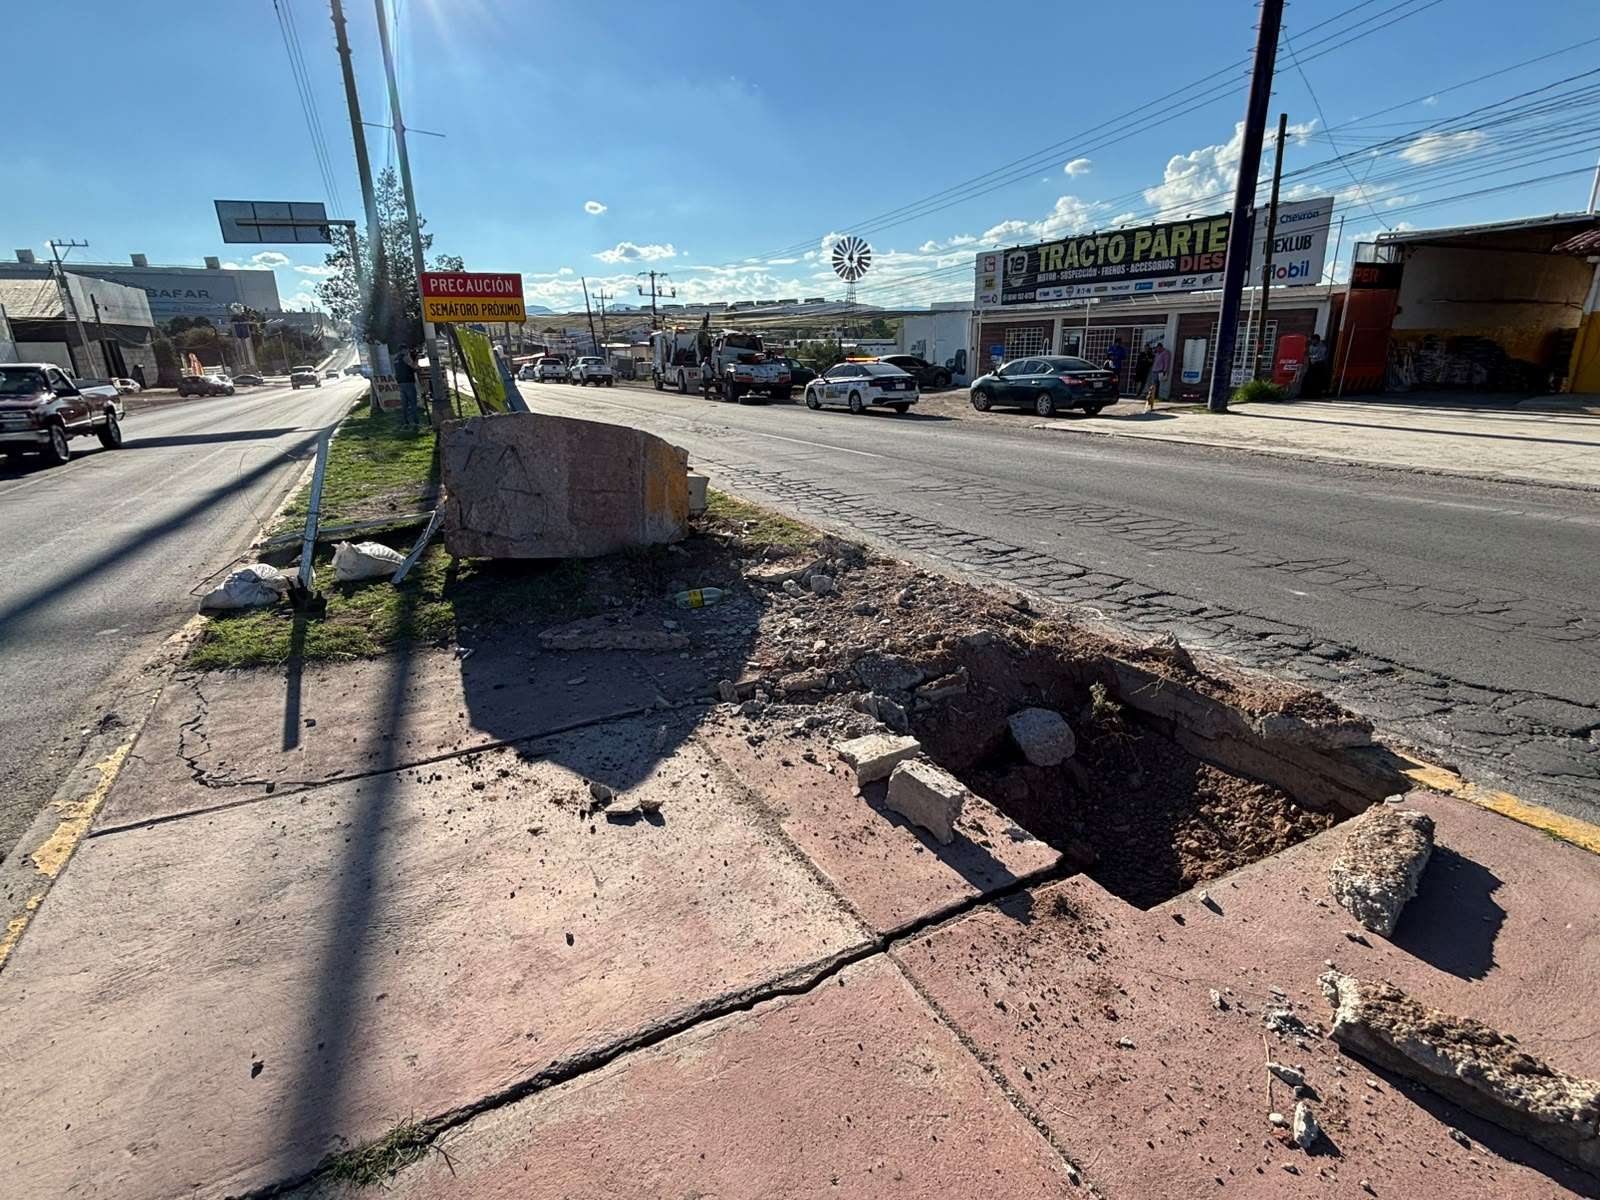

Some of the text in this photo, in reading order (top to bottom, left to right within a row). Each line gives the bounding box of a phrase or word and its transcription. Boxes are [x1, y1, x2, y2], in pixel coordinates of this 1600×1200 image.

[1279, 211, 1319, 224] Chevron
[1037, 234, 1126, 272] TRACTO
[1009, 256, 1025, 272] 18
[1101, 263, 1126, 276] FRENOS
[1129, 258, 1175, 273] ACCESORIOS
[430, 277, 513, 293] PRECAUCIÓN
[146, 288, 209, 299] BAFAR
[429, 300, 521, 316] SEMÁFORO PRÓXIMO
